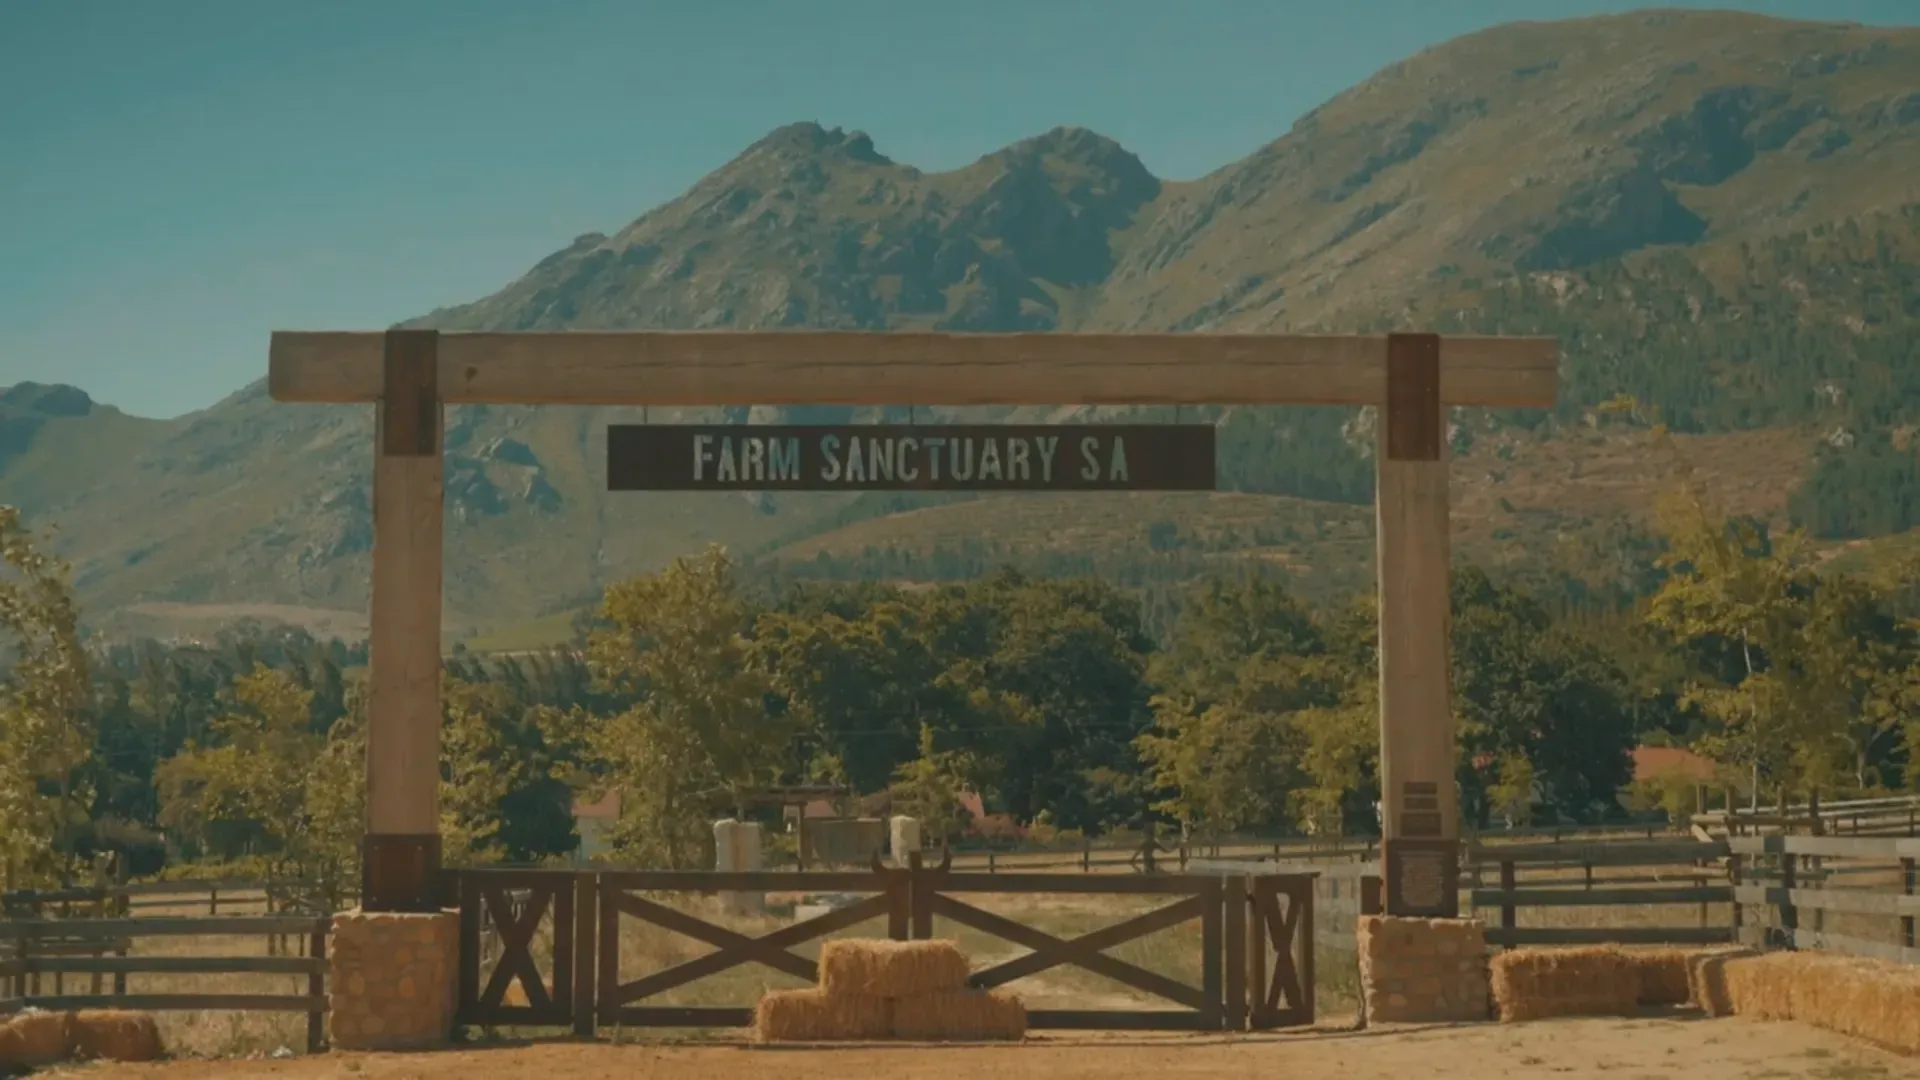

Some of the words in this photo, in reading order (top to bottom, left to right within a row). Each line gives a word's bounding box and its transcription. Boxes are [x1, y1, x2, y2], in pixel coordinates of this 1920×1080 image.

[692, 434, 801, 482] FARM
[820, 435, 1058, 482] SANCTUARY
[1080, 436, 1129, 481] SA
